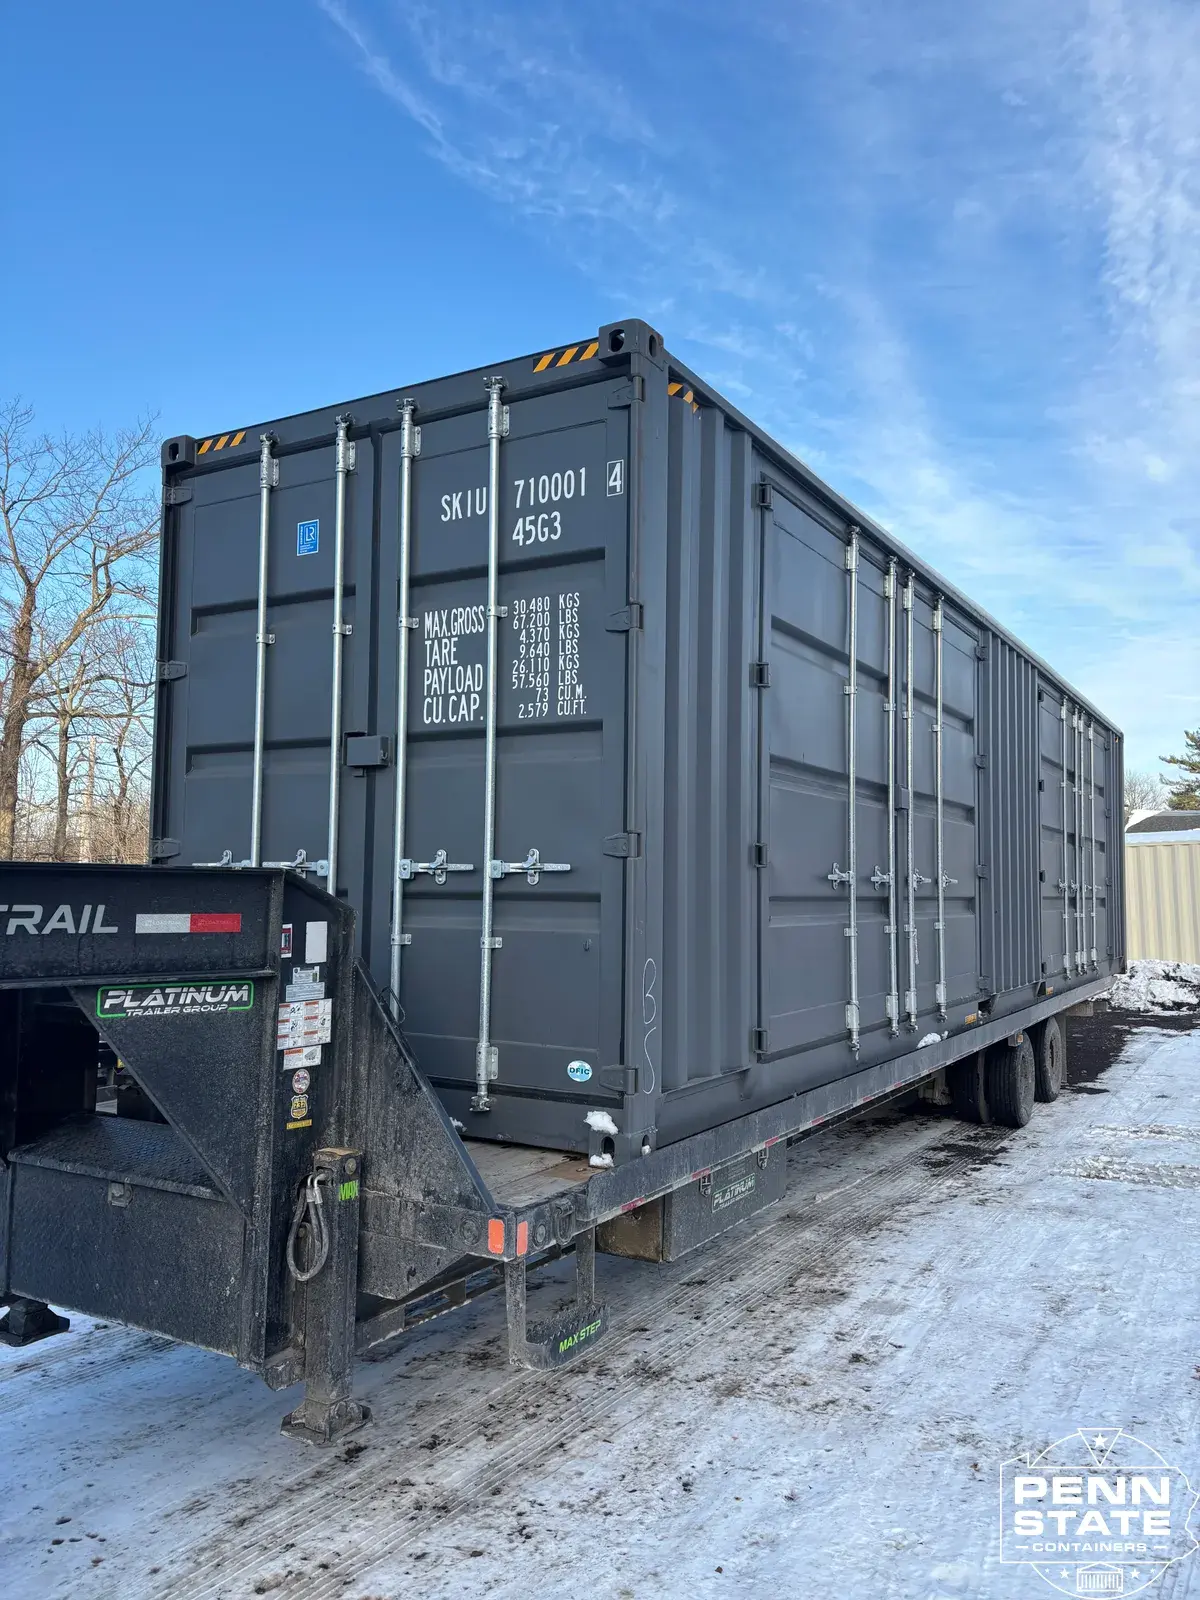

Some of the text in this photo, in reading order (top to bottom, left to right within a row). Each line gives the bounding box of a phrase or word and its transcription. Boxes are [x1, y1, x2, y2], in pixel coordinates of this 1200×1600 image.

[440, 462, 622, 522] SKIU 710001 4
[305, 526, 315, 542] LR
[512, 511, 562, 546] 45G3
[513, 592, 580, 615] 30,480 KGS
[513, 608, 579, 630] 67,200 LBS
[519, 623, 580, 644] 4,370 KGS
[424, 637, 459, 668] TARE
[519, 639, 579, 659] 9,640 LBS
[512, 654, 580, 675] 26,110 KGS
[424, 663, 484, 696] PAYLOAD
[512, 670, 578, 690] 57,560 LBS
[535, 687, 549, 703] 73
[103, 984, 249, 1009] PLATINUM
[126, 1003, 229, 1017] TRAILER GROUP
[559, 1319, 601, 1353] MAX STEP
